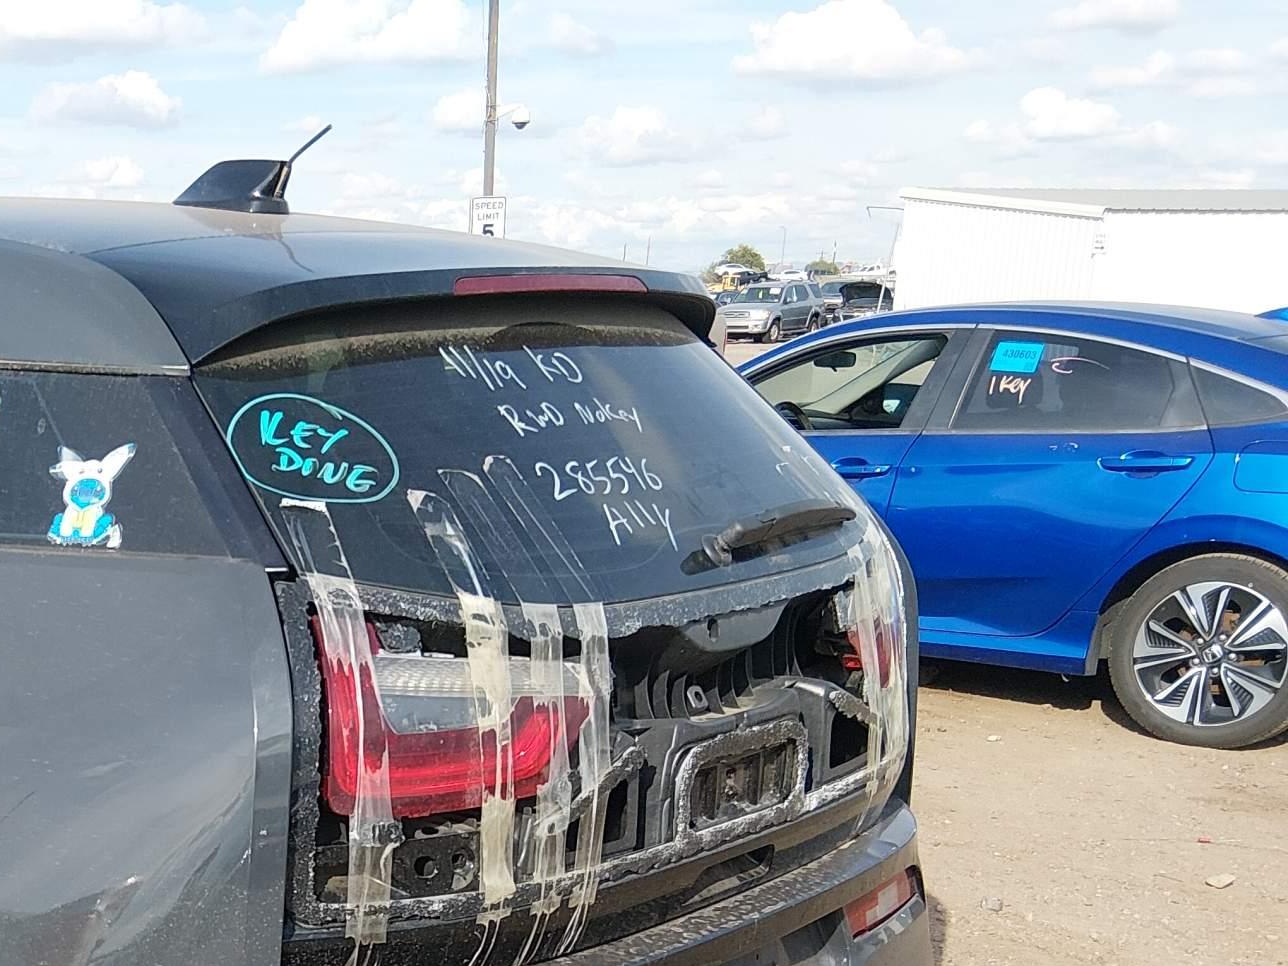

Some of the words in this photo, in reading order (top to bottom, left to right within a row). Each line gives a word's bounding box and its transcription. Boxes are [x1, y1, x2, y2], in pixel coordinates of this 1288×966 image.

[475, 201, 504, 210] SPEED
[477, 212, 500, 221] LIMIT
[482, 223, 495, 238] 5
[998, 375, 1032, 405] Key
[260, 410, 350, 455] KEY
[271, 446, 380, 493] DONE
[534, 456, 663, 501] 285546
